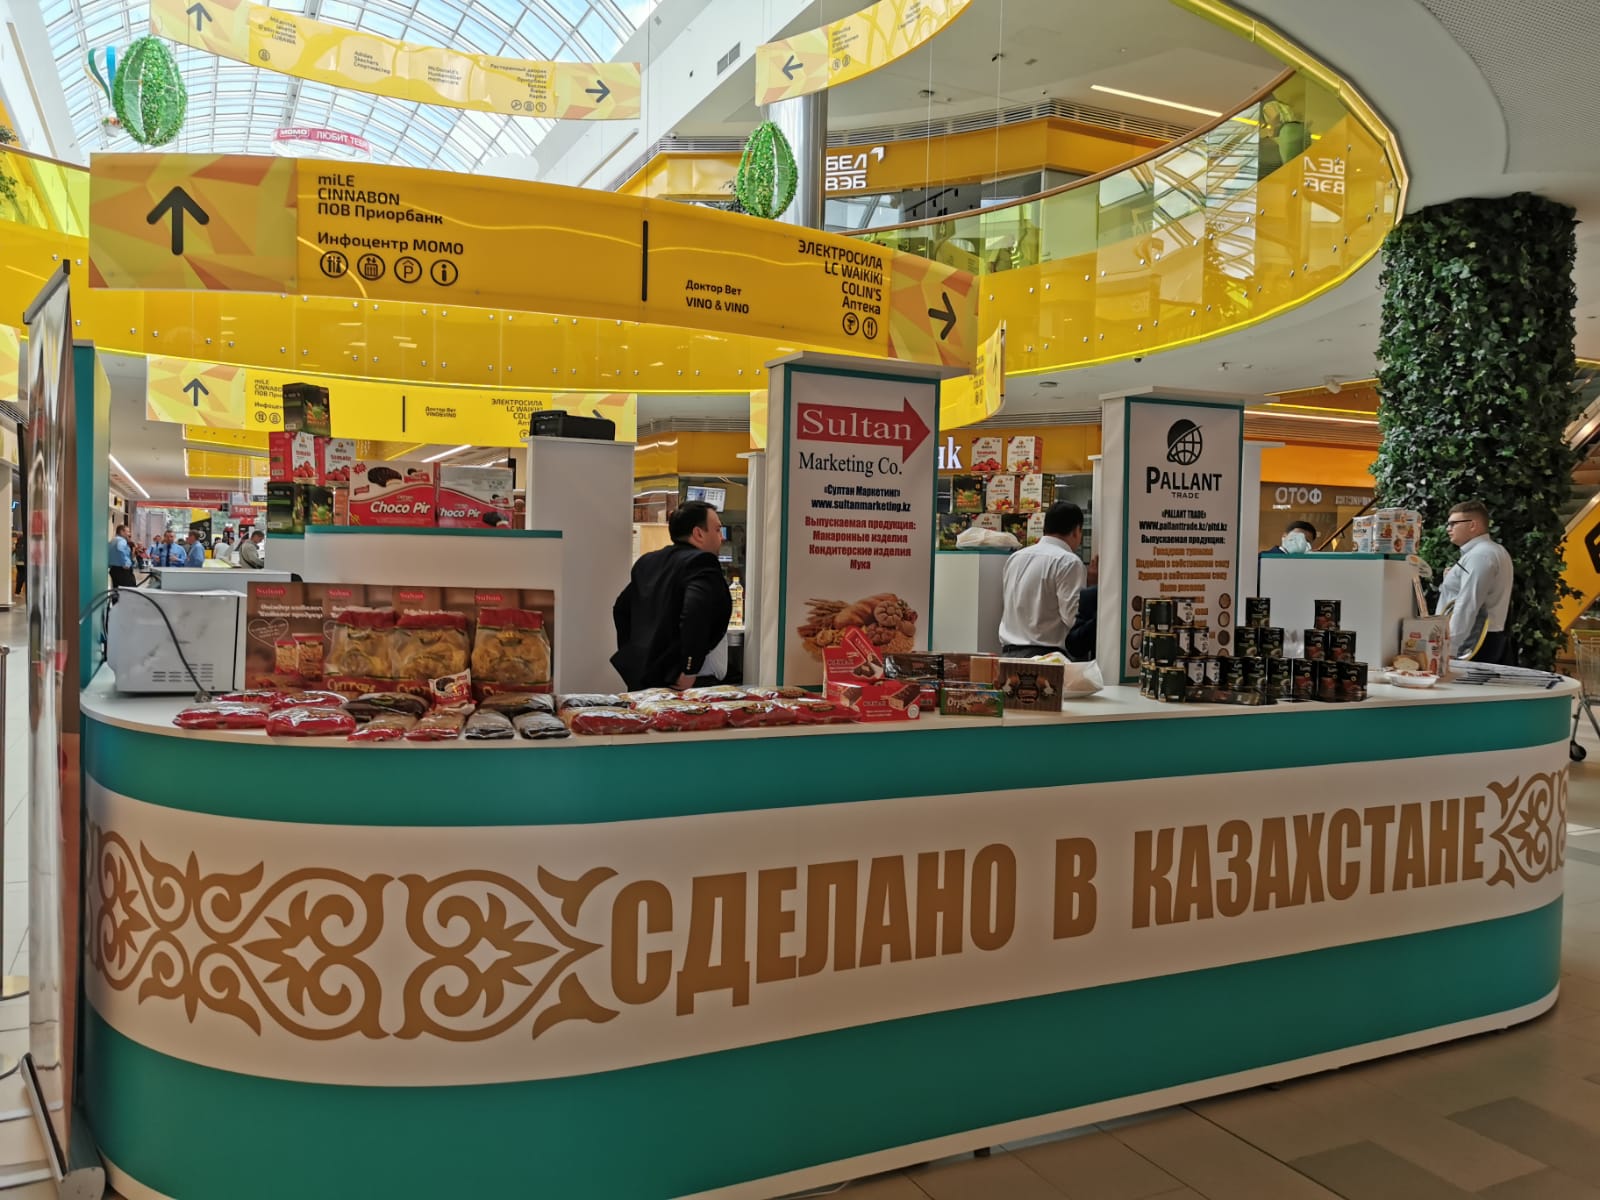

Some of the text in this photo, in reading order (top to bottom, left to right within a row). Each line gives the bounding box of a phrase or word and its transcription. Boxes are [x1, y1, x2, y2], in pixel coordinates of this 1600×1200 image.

[316, 131, 348, 141] ЛЮБИТ
[826, 153, 867, 171] БЕЛ
[318, 174, 355, 187] miLE
[825, 174, 867, 191] ВЭБ
[318, 187, 400, 206] CINNABON
[318, 202, 443, 224] ПОВ Приорбанк
[318, 232, 464, 255] Инфоцентр МОМО
[798, 240, 883, 270] ЭЛЕКТРОСИЛА
[824, 261, 883, 286] LC WAIKIKI
[685, 280, 742, 296] Доктор Вет
[841, 281, 882, 302] COLIN'S
[686, 296, 749, 314] VINO & VINO
[842, 296, 881, 315] Аптека
[491, 398, 543, 407] ЭЛЕКТРОСИЛА
[802, 409, 912, 441] Sultan
[799, 451, 903, 478] Marketing Co.
[1146, 466, 1223, 494] PALLANT
[824, 484, 901, 497] «Султан Маркетинг»
[1171, 491, 1200, 499] TRADE
[370, 500, 431, 514] Choco Pir
[440, 507, 481, 518] hoco Pir
[811, 498, 911, 513] www.sultanmarketing.kz
[805, 516, 917, 531] Выпускаемая продукция:
[813, 530, 908, 544] Макаронные изделия
[1141, 534, 1226, 545] Выпускаемая продукция:
[809, 544, 911, 558] Кондитерские изделия
[850, 559, 871, 571] Мука
[610, 794, 1488, 1017] СДЕЛАНО В КАЗАХСТАНЕ
